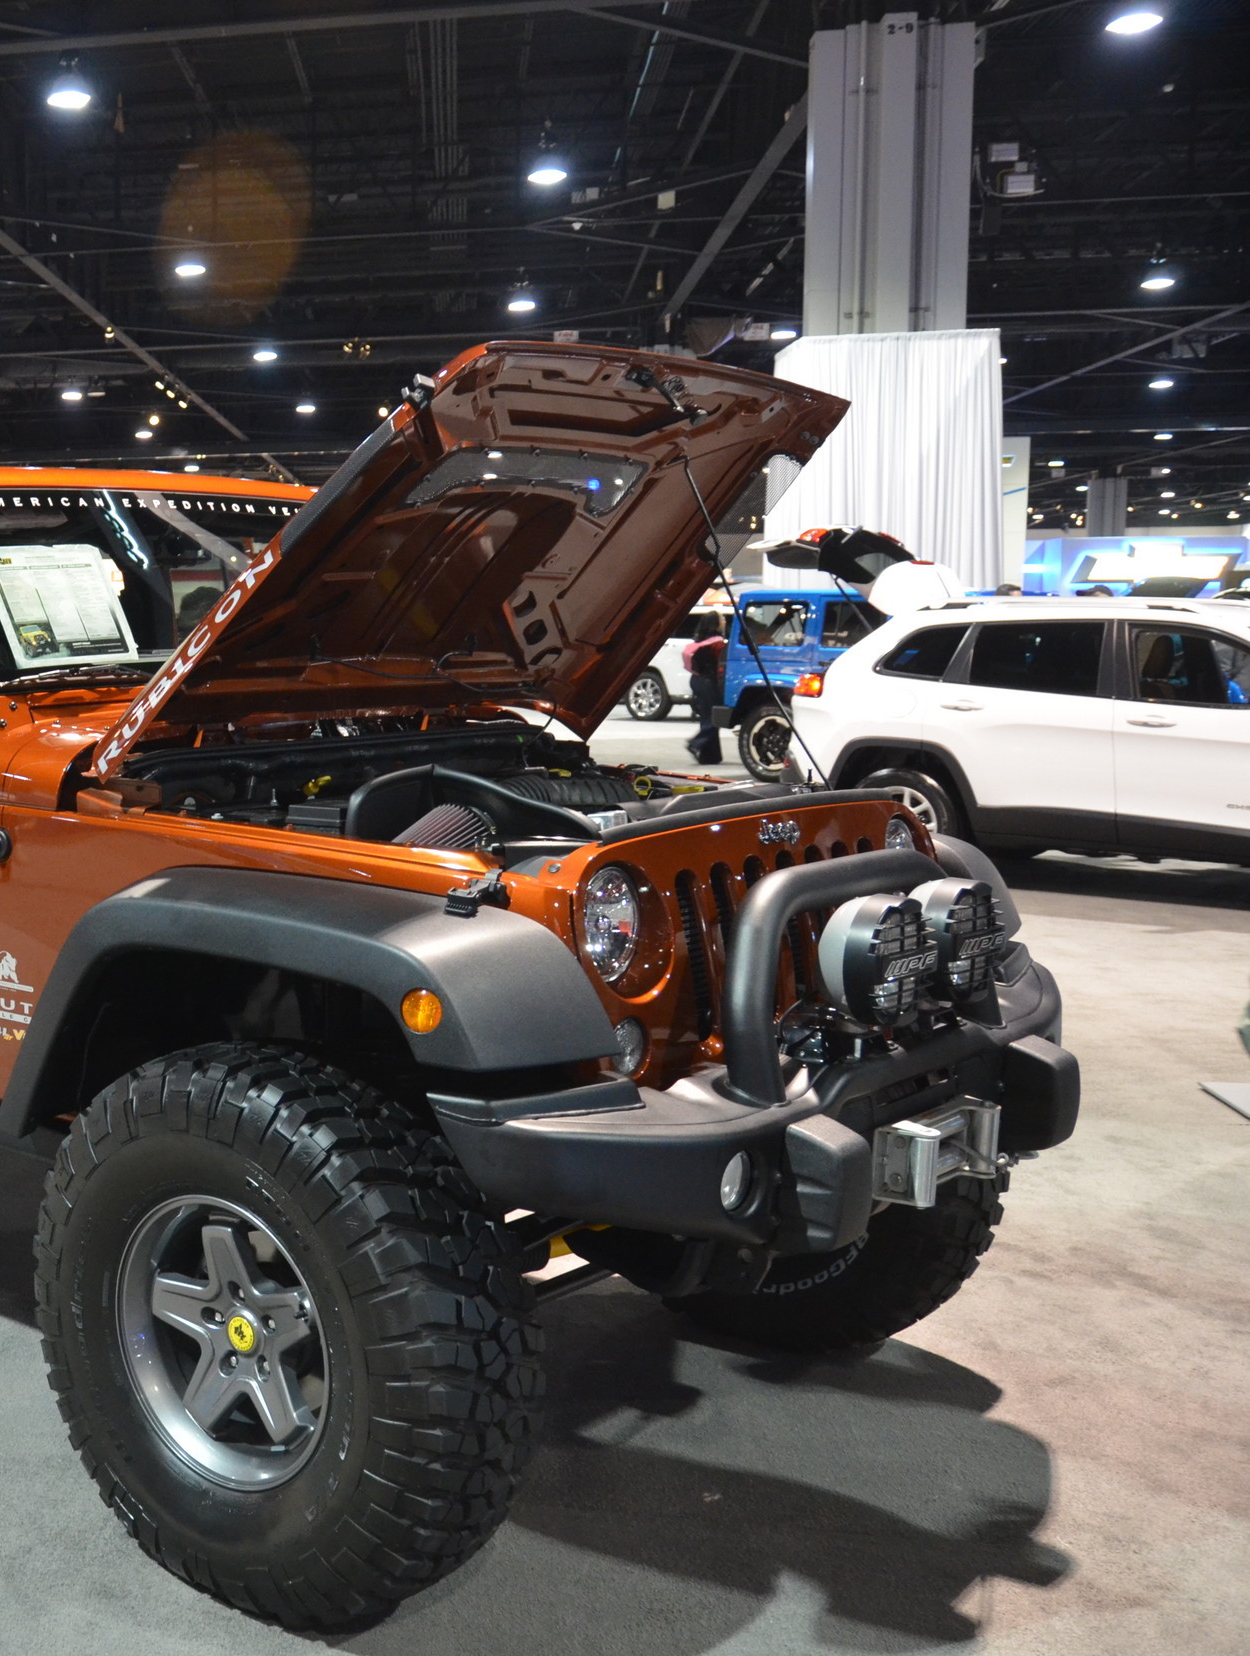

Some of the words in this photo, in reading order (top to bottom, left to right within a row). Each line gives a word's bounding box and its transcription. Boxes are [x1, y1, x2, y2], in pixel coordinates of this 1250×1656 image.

[121, 497, 254, 514] EXPEDITION
[97, 551, 274, 776] RUBICON
[758, 818, 801, 845] Jeep
